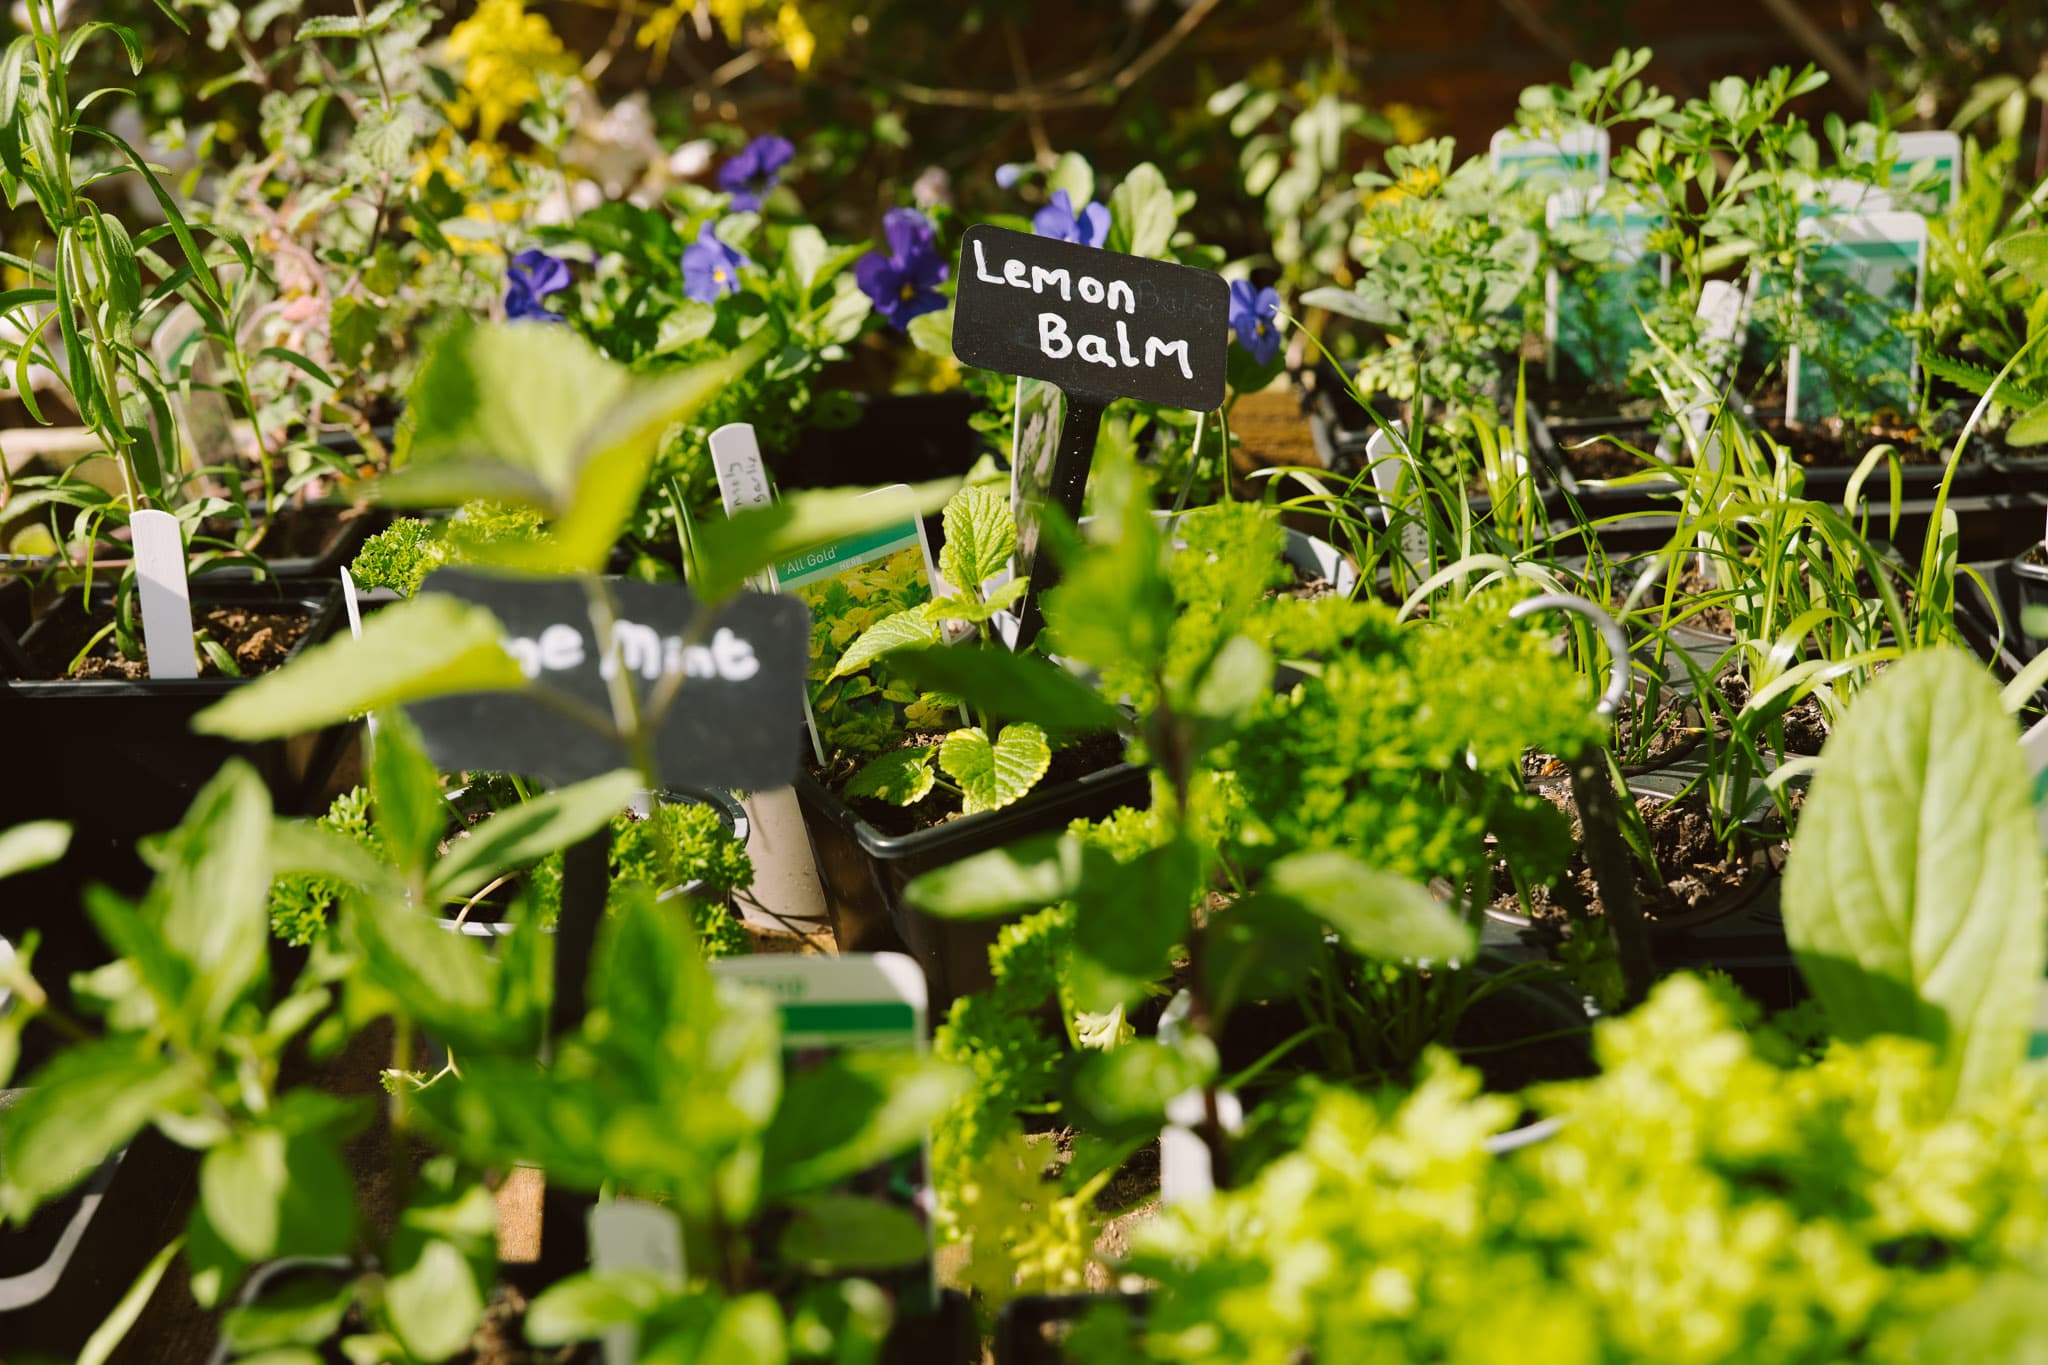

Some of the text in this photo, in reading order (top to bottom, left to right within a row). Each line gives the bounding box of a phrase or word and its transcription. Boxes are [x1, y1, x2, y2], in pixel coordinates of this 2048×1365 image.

[973, 239, 1135, 314] Lemon
[1038, 312, 1194, 380] Balm
[600, 619, 760, 682] Mint
